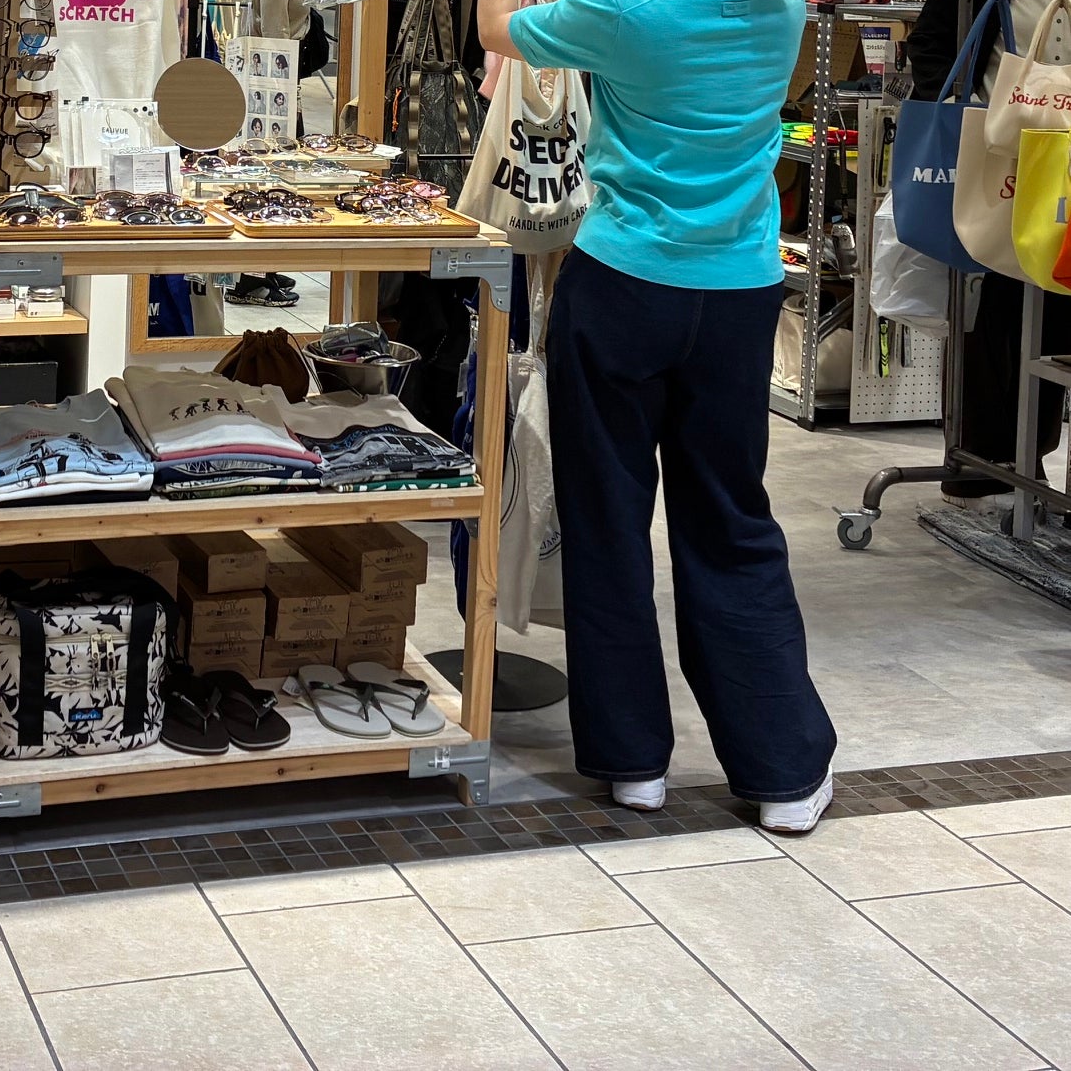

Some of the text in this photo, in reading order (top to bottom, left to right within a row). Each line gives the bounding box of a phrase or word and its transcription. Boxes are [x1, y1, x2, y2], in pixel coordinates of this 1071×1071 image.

[59, 6, 135, 22] SCRATCH
[1008, 85, 1049, 106] Saint
[509, 215, 545, 232] HANDLE
[547, 219, 569, 231] WITH
